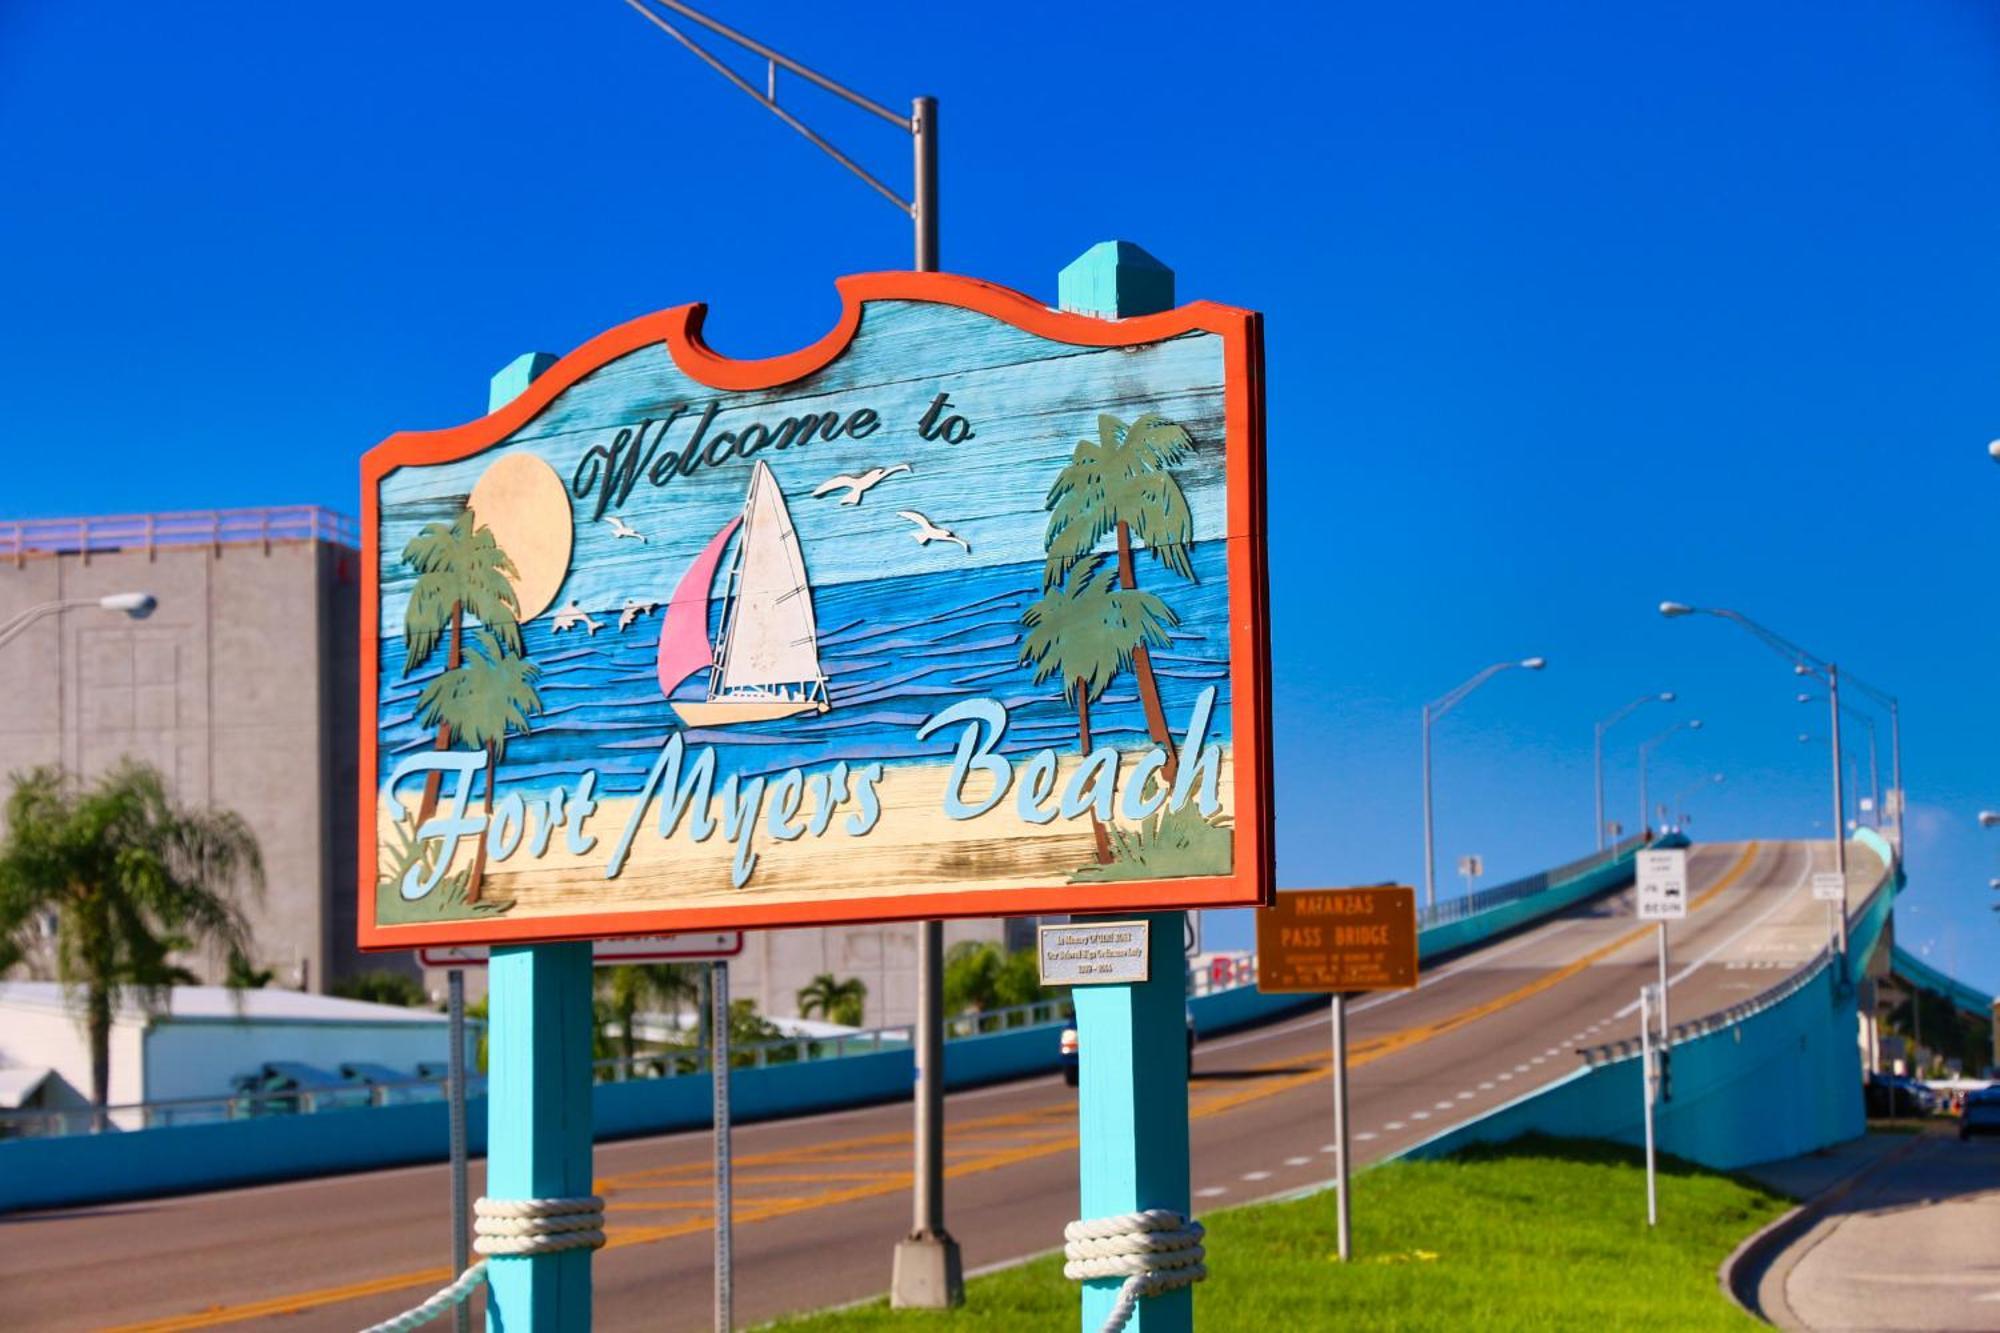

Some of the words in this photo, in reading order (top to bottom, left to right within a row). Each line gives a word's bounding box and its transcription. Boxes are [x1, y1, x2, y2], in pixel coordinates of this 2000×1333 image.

[572, 399, 881, 522] Welcome
[918, 392, 976, 445] to
[384, 750, 598, 900] Fort
[606, 731, 884, 889] Myers
[915, 685, 1223, 825] Beach
[1295, 895, 1374, 915] MATANZAS
[1644, 903, 1681, 913] BEGIN
[1281, 926, 1322, 947] PASS
[1335, 924, 1389, 945] BRIDGE
